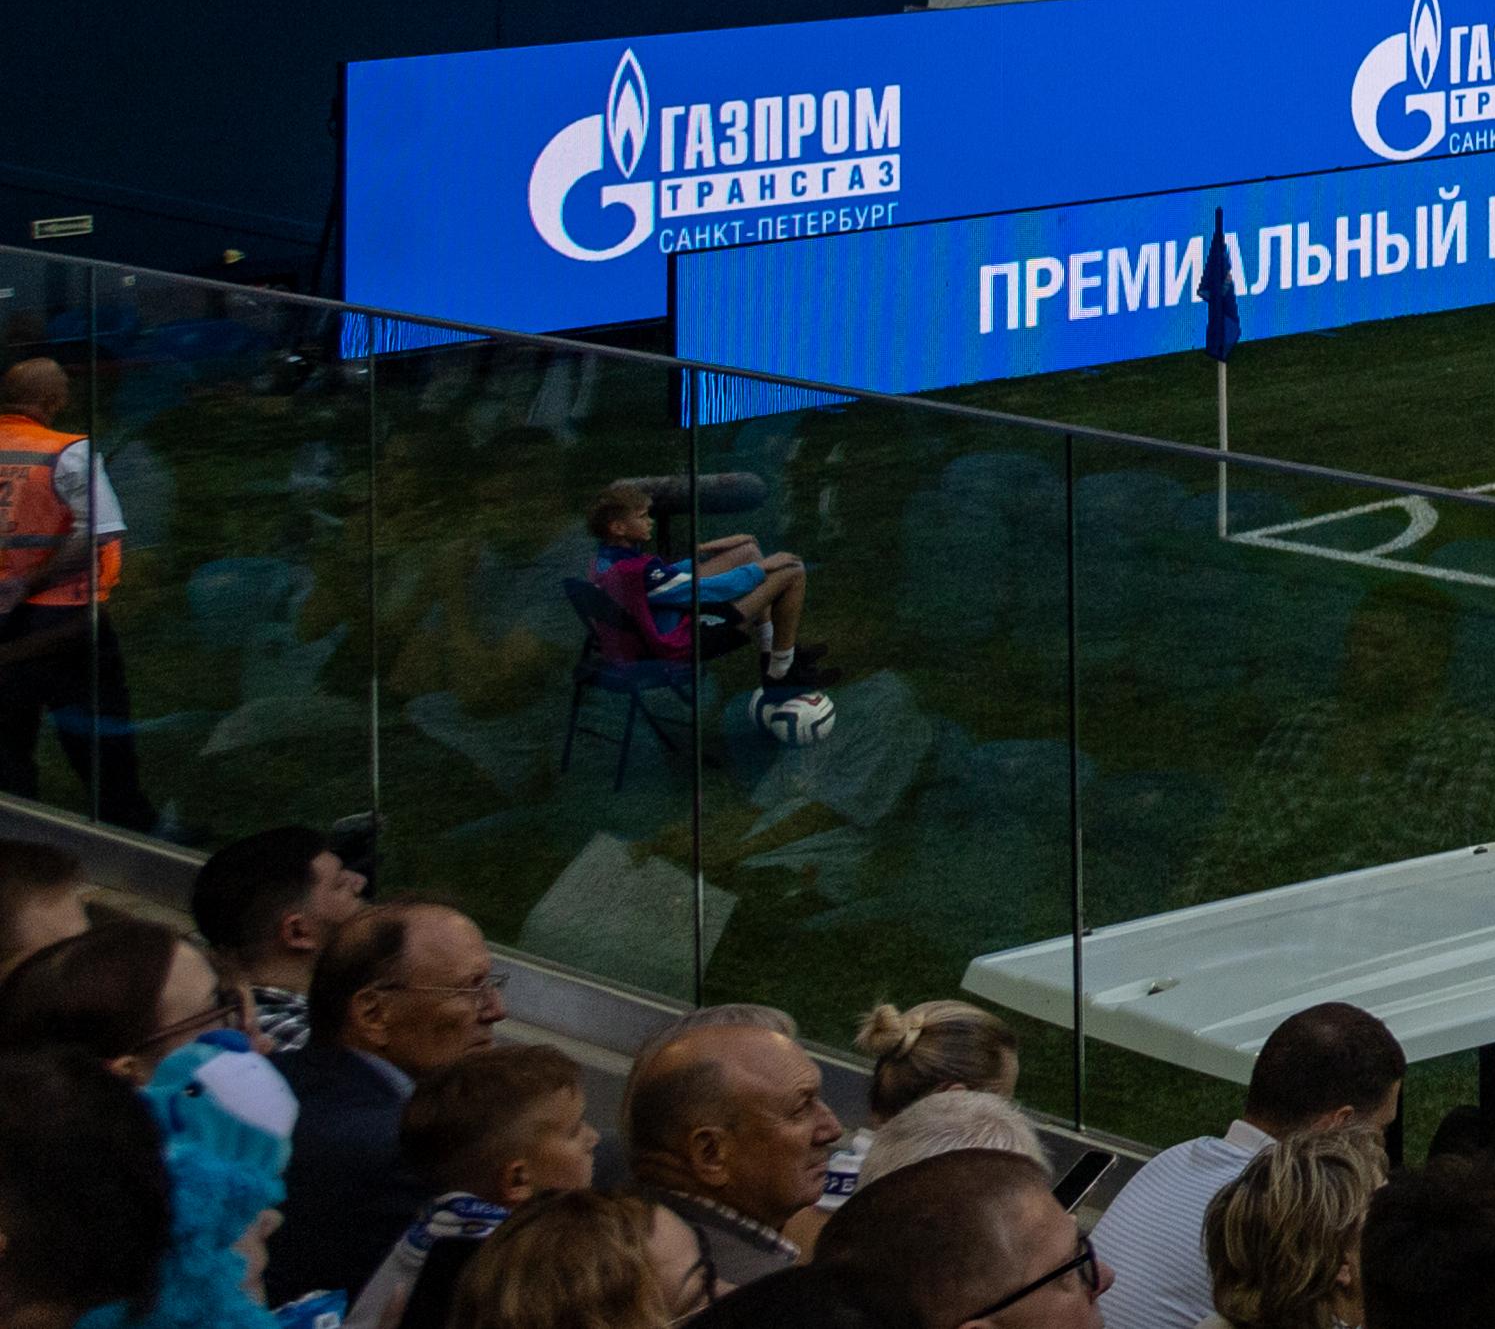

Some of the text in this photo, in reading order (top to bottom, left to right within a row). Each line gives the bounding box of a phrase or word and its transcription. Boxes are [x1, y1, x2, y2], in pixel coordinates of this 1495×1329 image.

[659, 84, 902, 172] ГАЗПРОМ
[665, 157, 897, 206] ТРАНСГАЗ
[659, 201, 901, 255] САНКТ-ПЕТЕРБУРГ
